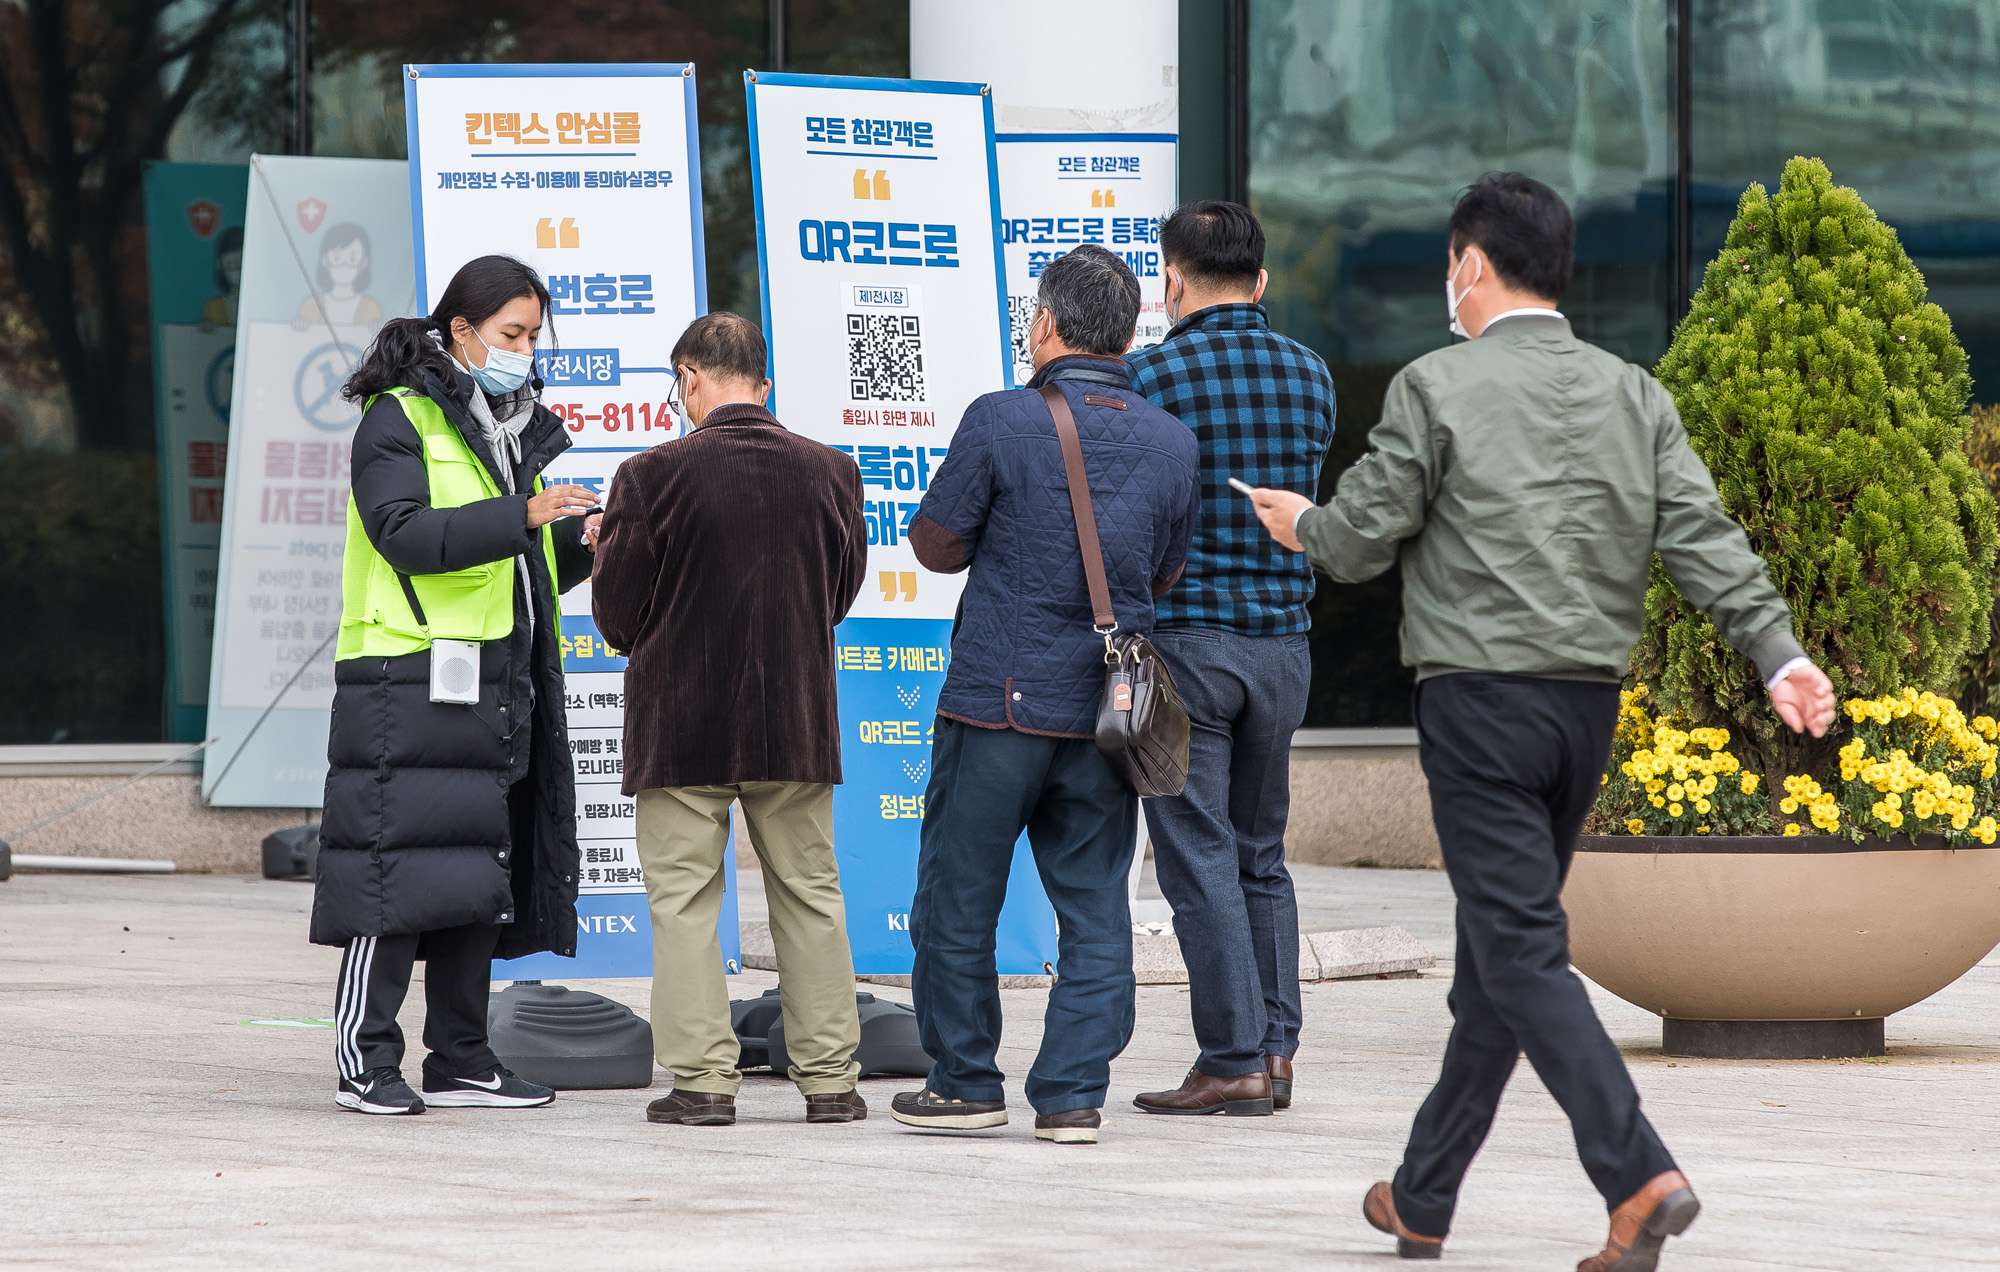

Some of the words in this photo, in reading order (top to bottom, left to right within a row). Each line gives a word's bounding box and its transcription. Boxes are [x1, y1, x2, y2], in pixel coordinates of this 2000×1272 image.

[465, 112, 550, 145] 킨텍스
[556, 111, 641, 144] 안심콜
[805, 116, 847, 144] 모든
[851, 118, 935, 148] 참관객은
[1058, 156, 1087, 172] 모든
[1090, 156, 1140, 172] 참관객은
[437, 171, 498, 190] 개인정보
[500, 170, 581, 189] 수집·이용에
[583, 170, 674, 189] 동의하실경우
[1001, 217, 1105, 244] QR코드로
[799, 219, 961, 268] QR코드로
[548, 273, 656, 316] 번호로
[859, 289, 904, 304] 제1전시장
[842, 408, 879, 426] 출입시
[882, 409, 907, 427] 화면
[910, 411, 936, 428] 제시
[826, 444, 949, 491] 록하
[887, 646, 945, 672] 카메라
[859, 720, 922, 745] QR코드
[605, 738, 618, 754] 및
[584, 803, 636, 819] 입장시간
[586, 847, 624, 863] 종료시
[587, 868, 601, 883] 후
[604, 868, 645, 883] 자동삭
